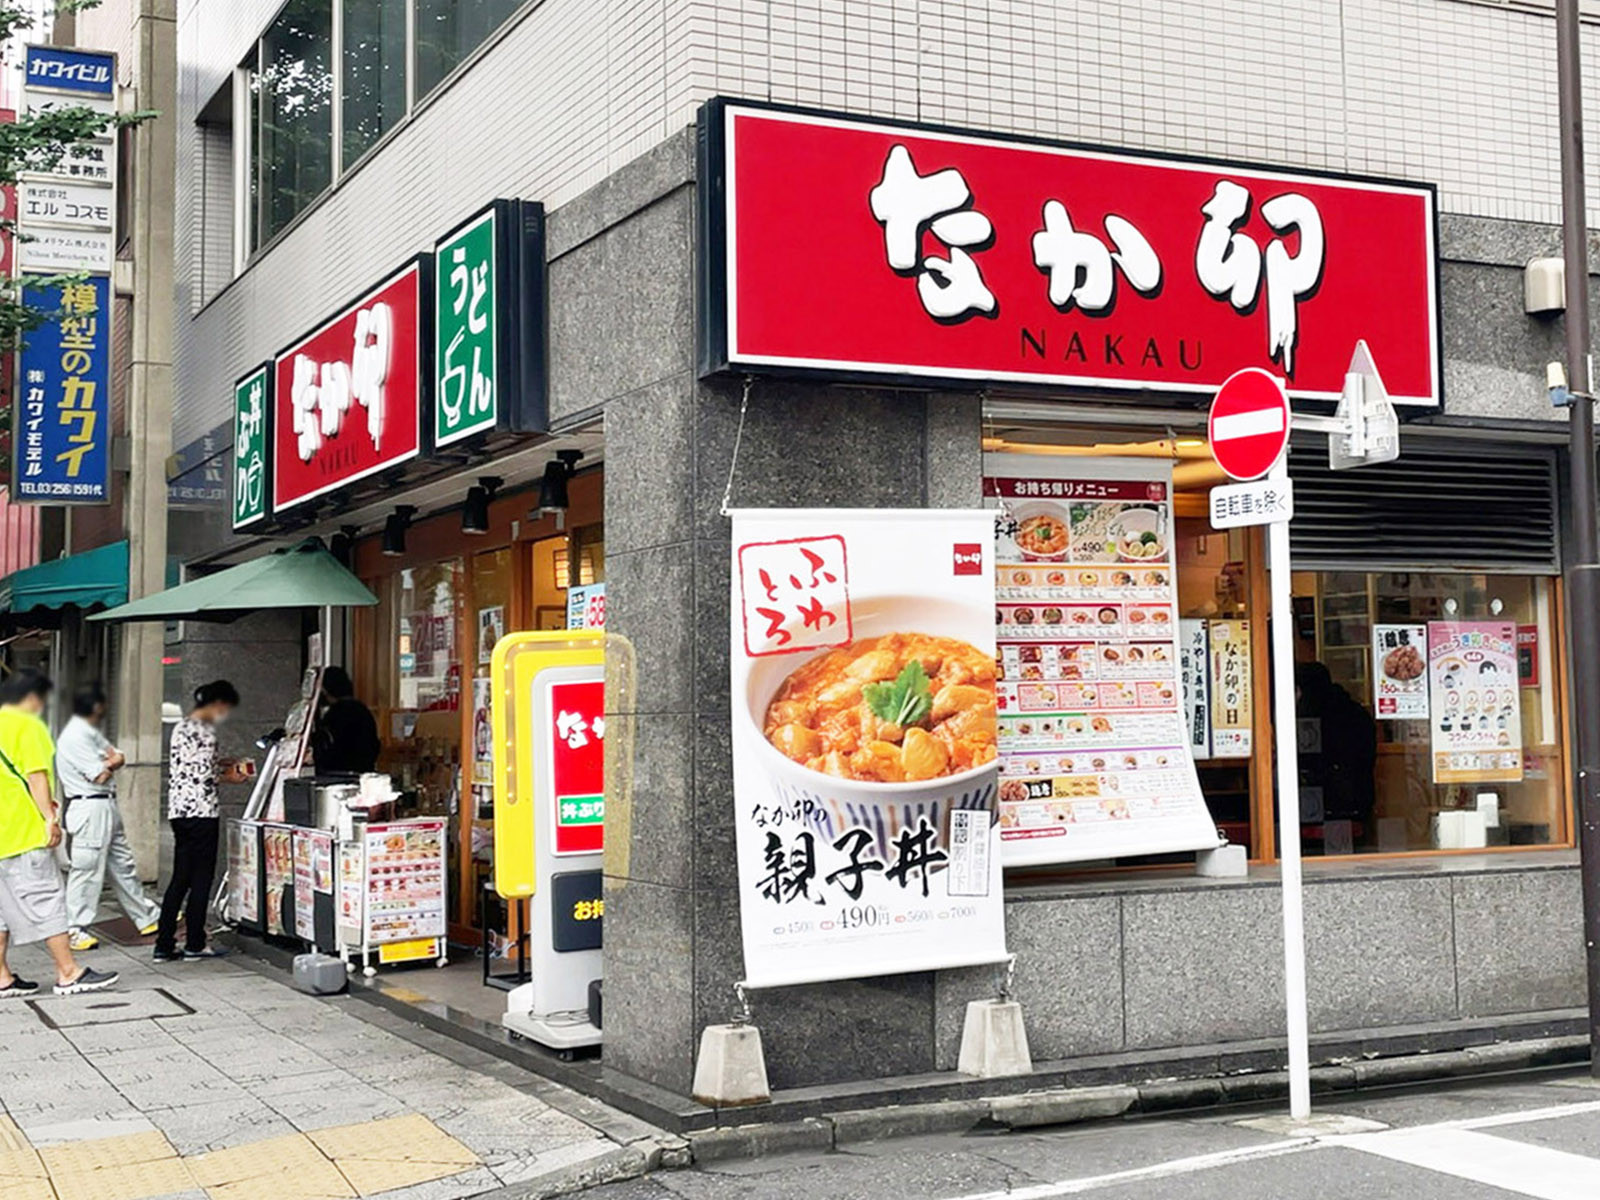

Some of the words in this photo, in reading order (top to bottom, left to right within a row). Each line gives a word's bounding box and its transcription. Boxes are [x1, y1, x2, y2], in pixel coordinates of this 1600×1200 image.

[29, 58, 110, 83] カワイビル
[27, 188, 68, 200] 株式会社
[869, 144, 1324, 380] なか卯
[1020, 326, 1204, 371] NAKAU
[1215, 489, 1287, 519] 自転車を除く
[750, 799, 828, 828] なか卯の
[755, 818, 949, 906] 親子丼
